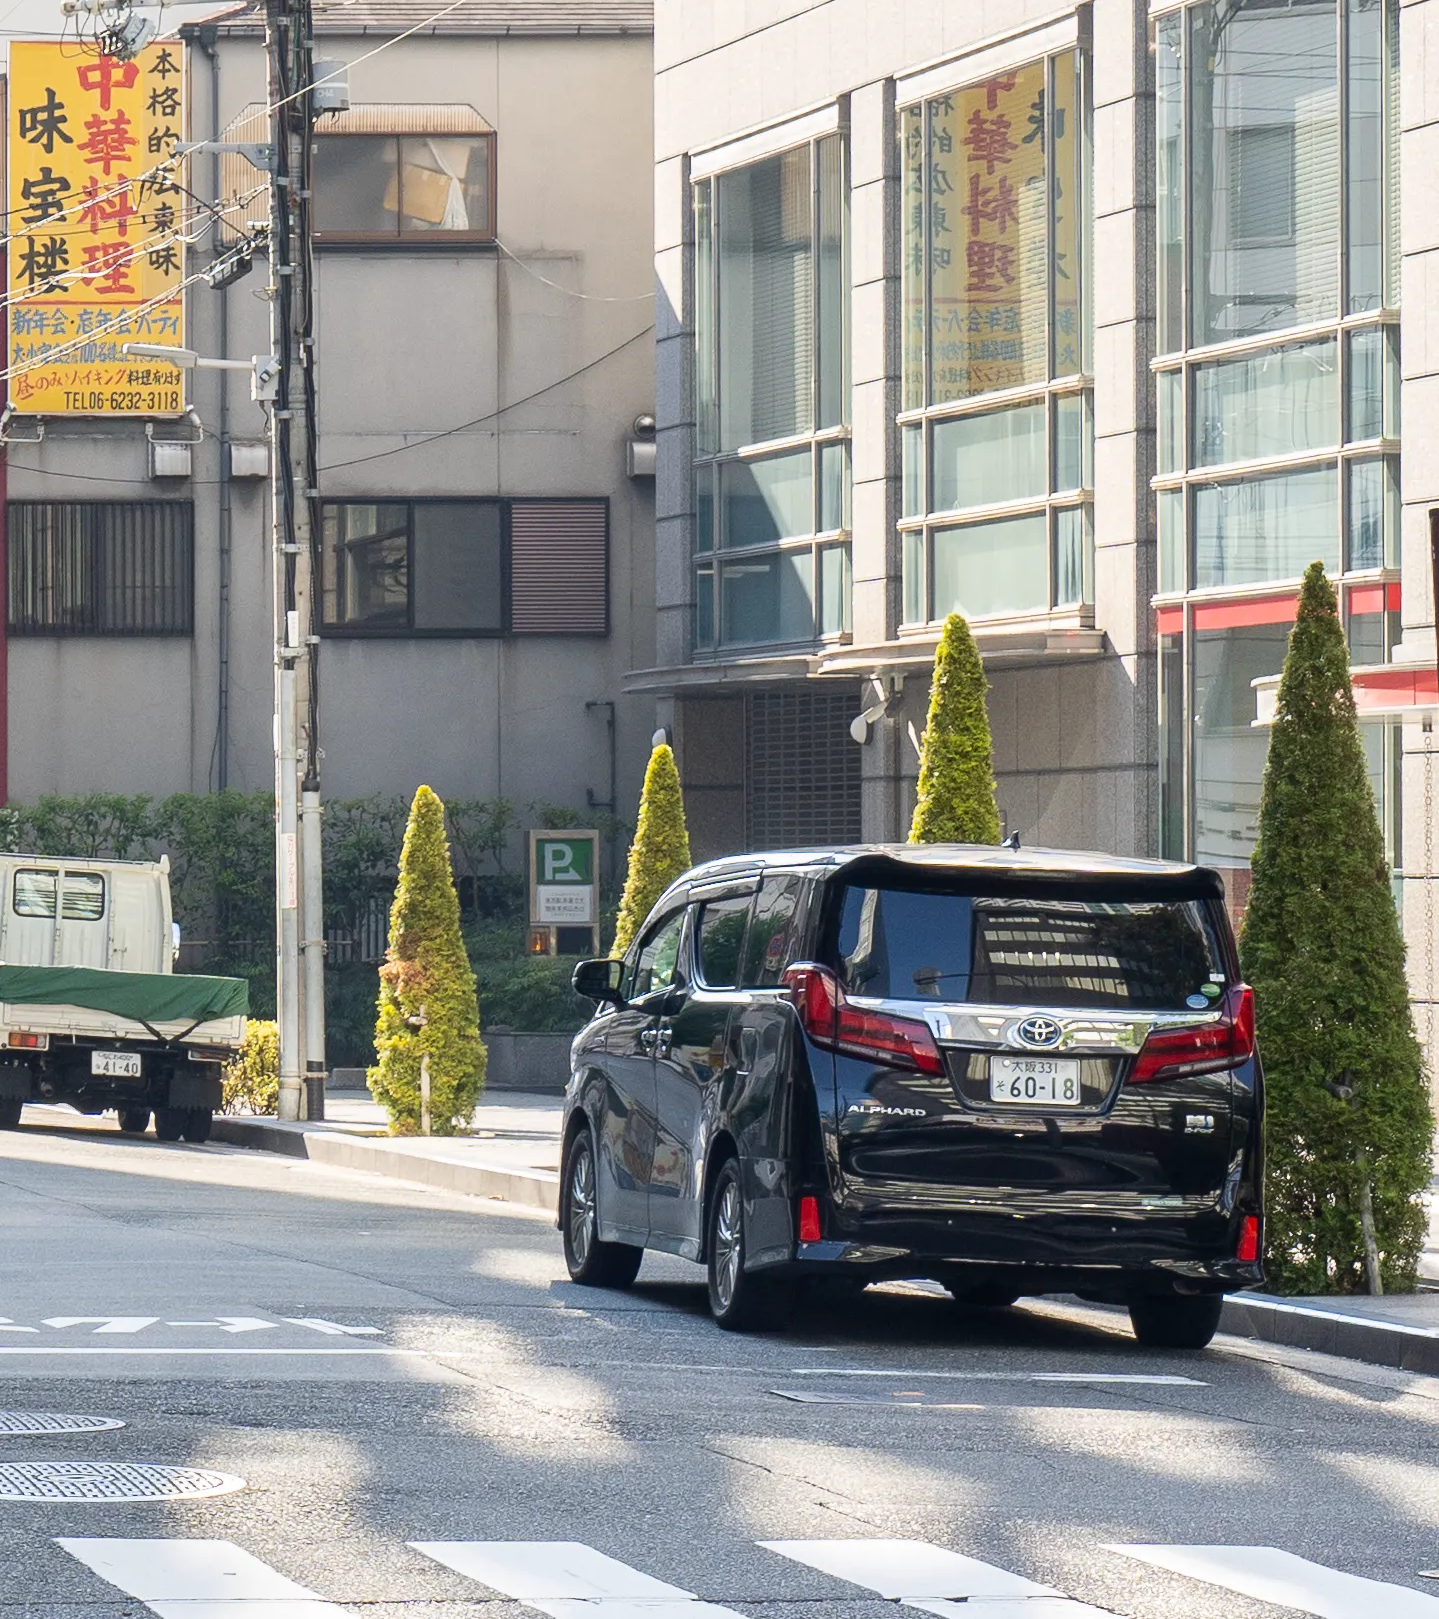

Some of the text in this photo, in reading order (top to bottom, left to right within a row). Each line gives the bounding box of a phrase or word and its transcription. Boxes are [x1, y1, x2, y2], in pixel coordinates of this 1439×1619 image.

[76, 55, 140, 296] 中華料理
[17, 87, 74, 294] 味宝楼
[64, 391, 178, 411] TEL06-6232-3118
[103, 1060, 139, 1074] 41-40
[1010, 1076, 1075, 1101] 60-18
[847, 1105, 927, 1117] ALPHARD
